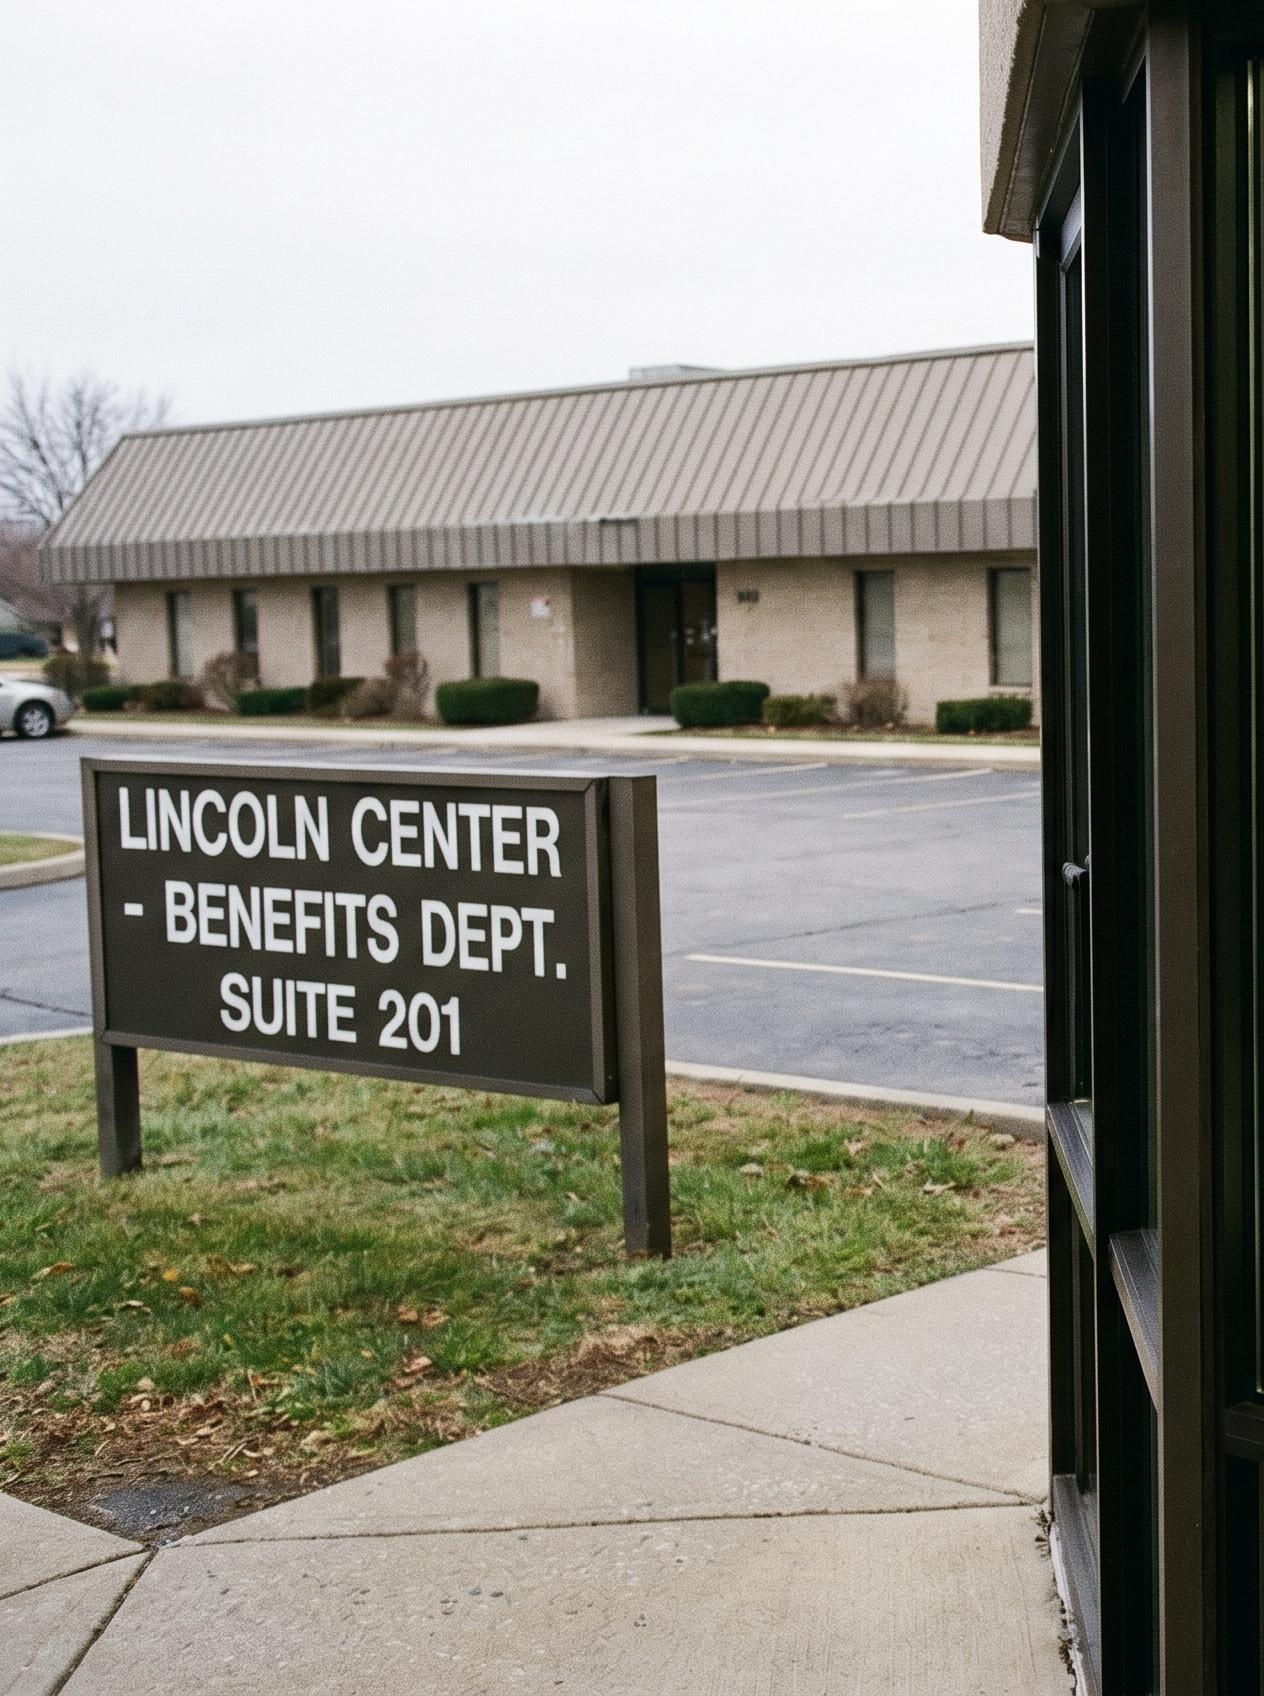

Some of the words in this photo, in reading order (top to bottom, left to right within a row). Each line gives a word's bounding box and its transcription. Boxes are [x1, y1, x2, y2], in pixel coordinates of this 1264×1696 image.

[118, 786, 330, 862] LINCOLN
[350, 796, 562, 878] CENTER
[123, 902, 144, 917] -
[164, 879, 400, 965] BENEFITS
[420, 898, 568, 981] DEPT.
[219, 971, 357, 1044] SUITE
[377, 988, 461, 1056] 201
